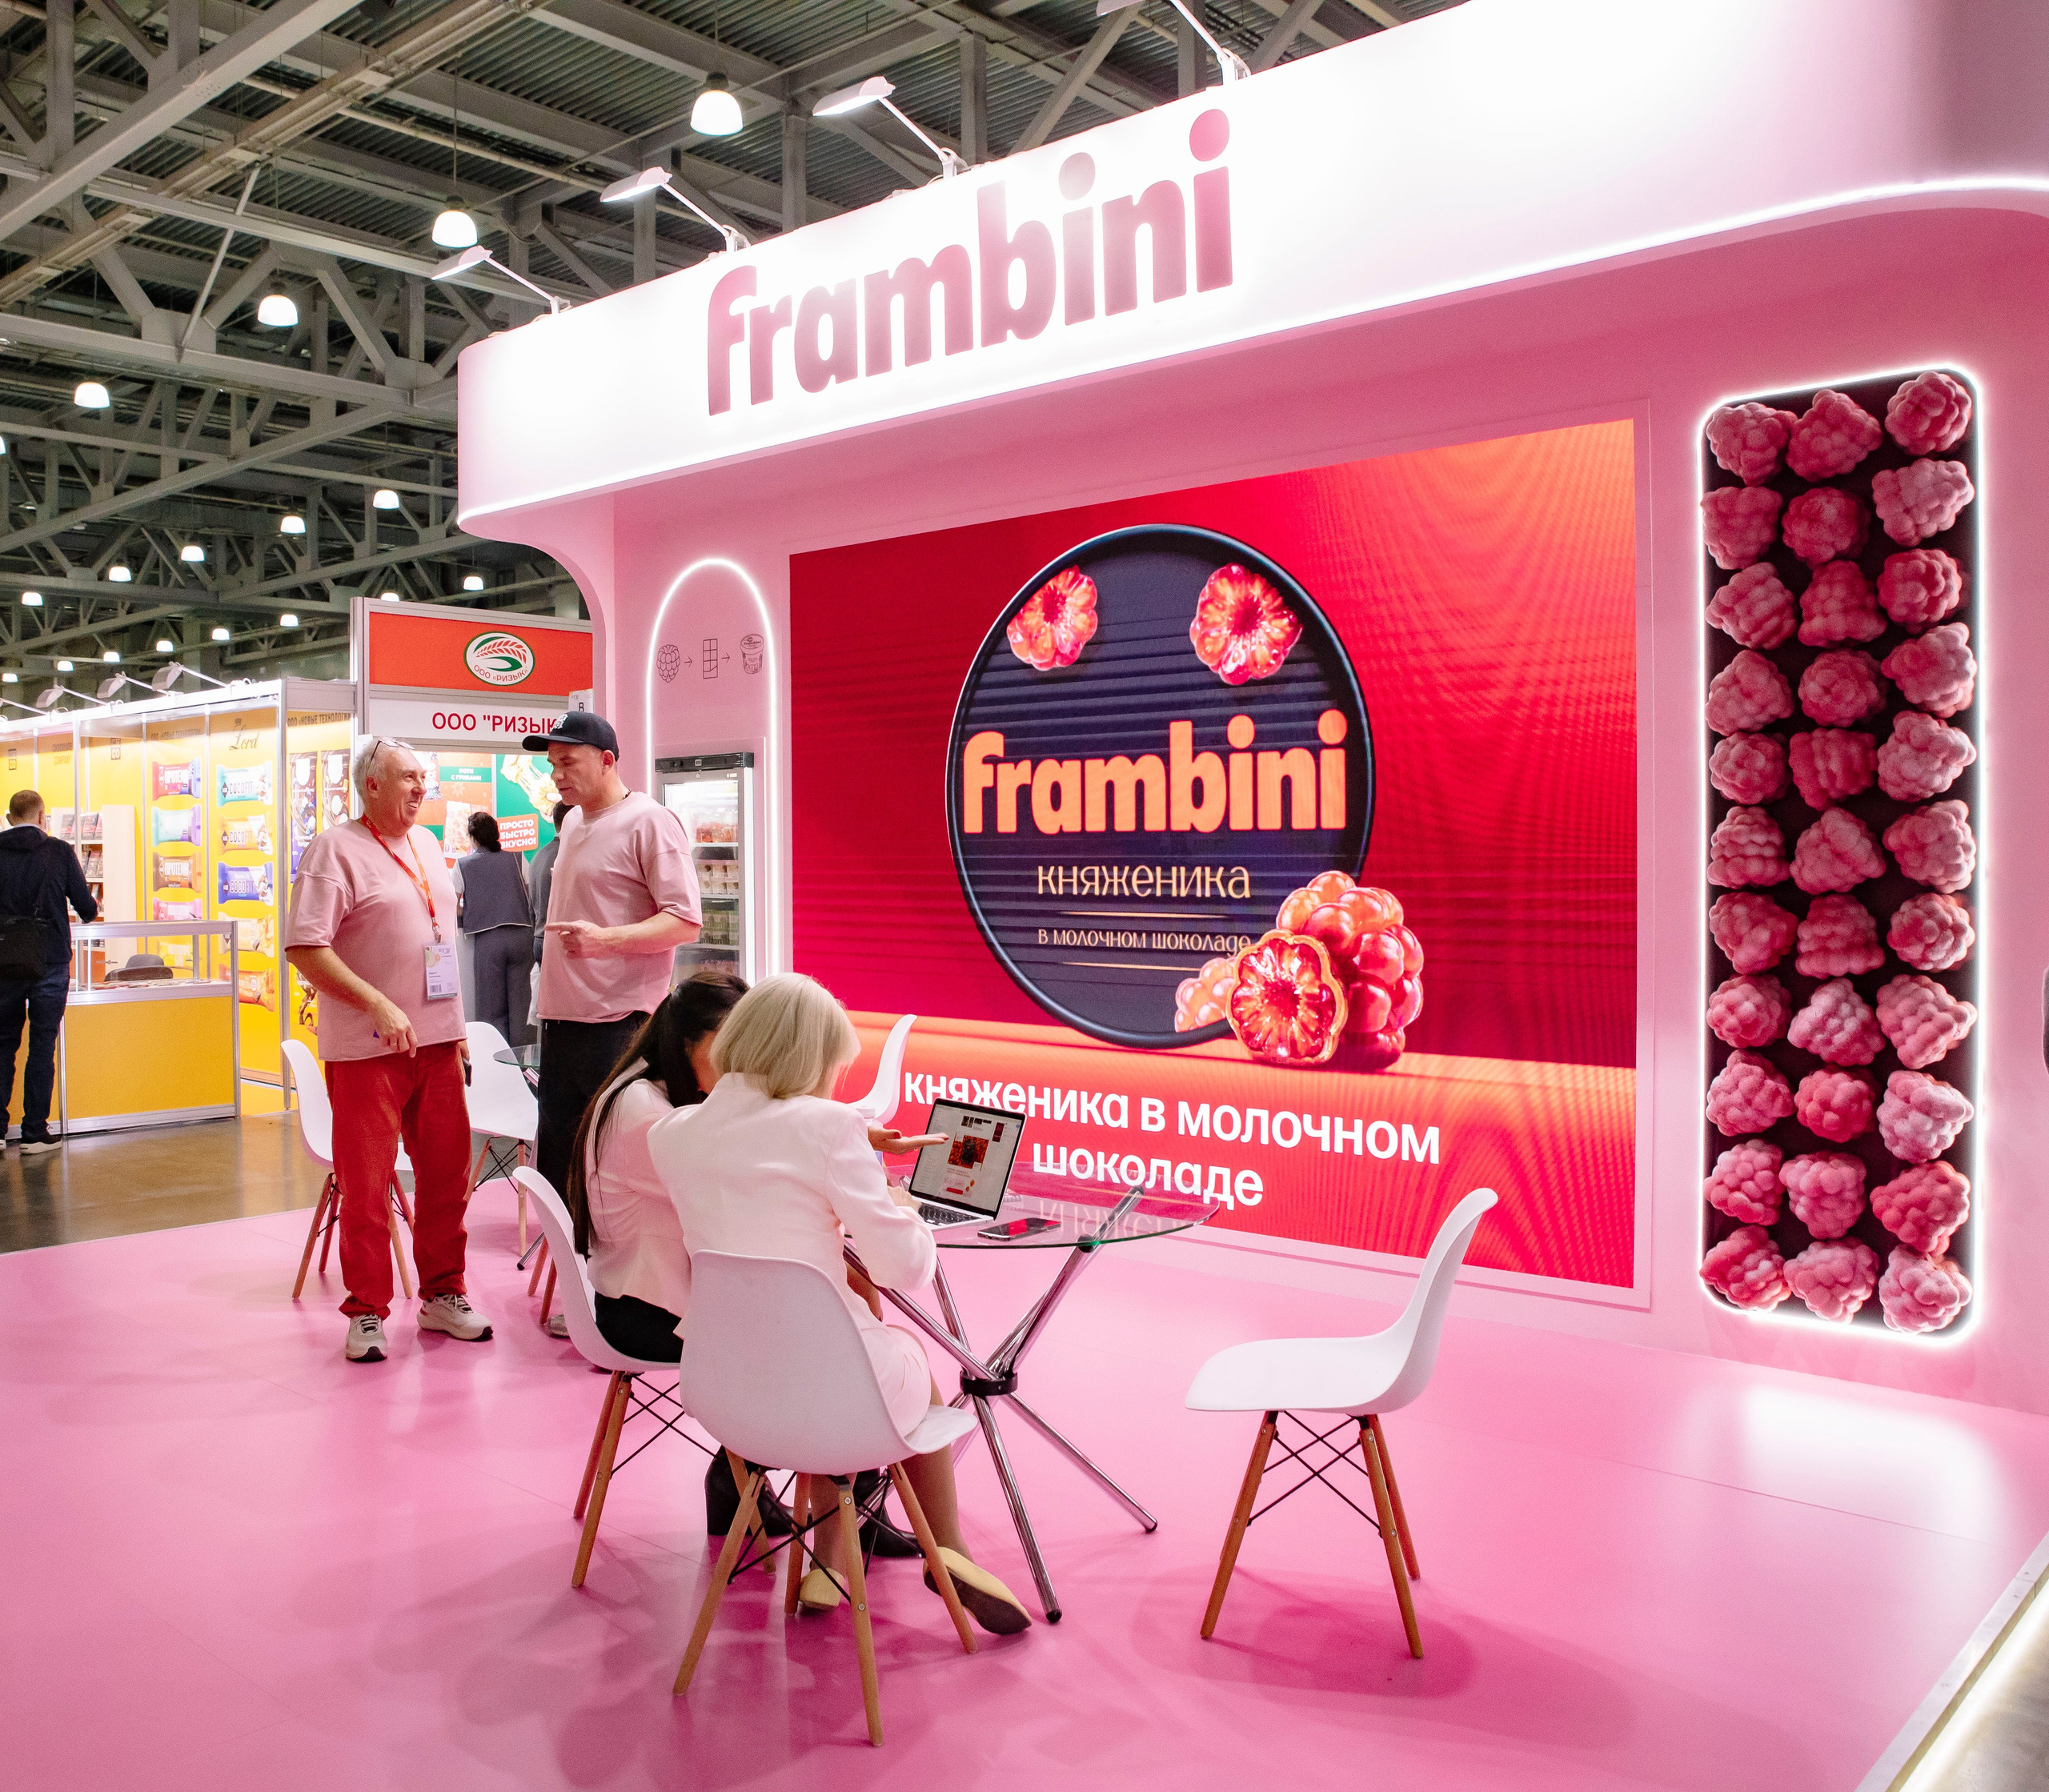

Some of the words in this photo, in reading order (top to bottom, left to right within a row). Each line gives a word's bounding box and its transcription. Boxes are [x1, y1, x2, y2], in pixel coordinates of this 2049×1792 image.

[708, 108, 1233, 416] frambini
[474, 664, 491, 679] ООО
[432, 712, 476, 730] ООО
[229, 724, 260, 750] Lord
[963, 709, 1348, 834] frambini
[499, 819, 535, 831] ПРОСТО
[499, 828, 535, 840] БЫСТРО
[501, 836, 536, 849] ВКУСНО!
[164, 862, 189, 876] ПРОТЕИН
[1037, 864, 1251, 899] княженика
[1038, 928, 1049, 944] в
[1053, 929, 1146, 948] молочном
[1152, 932, 1252, 957] шоколаде
[904, 1072, 1129, 1129] княженика
[1141, 1097, 1165, 1133] в
[1177, 1100, 1440, 1165] молочном
[1033, 1143, 1264, 1211] шоколаде
